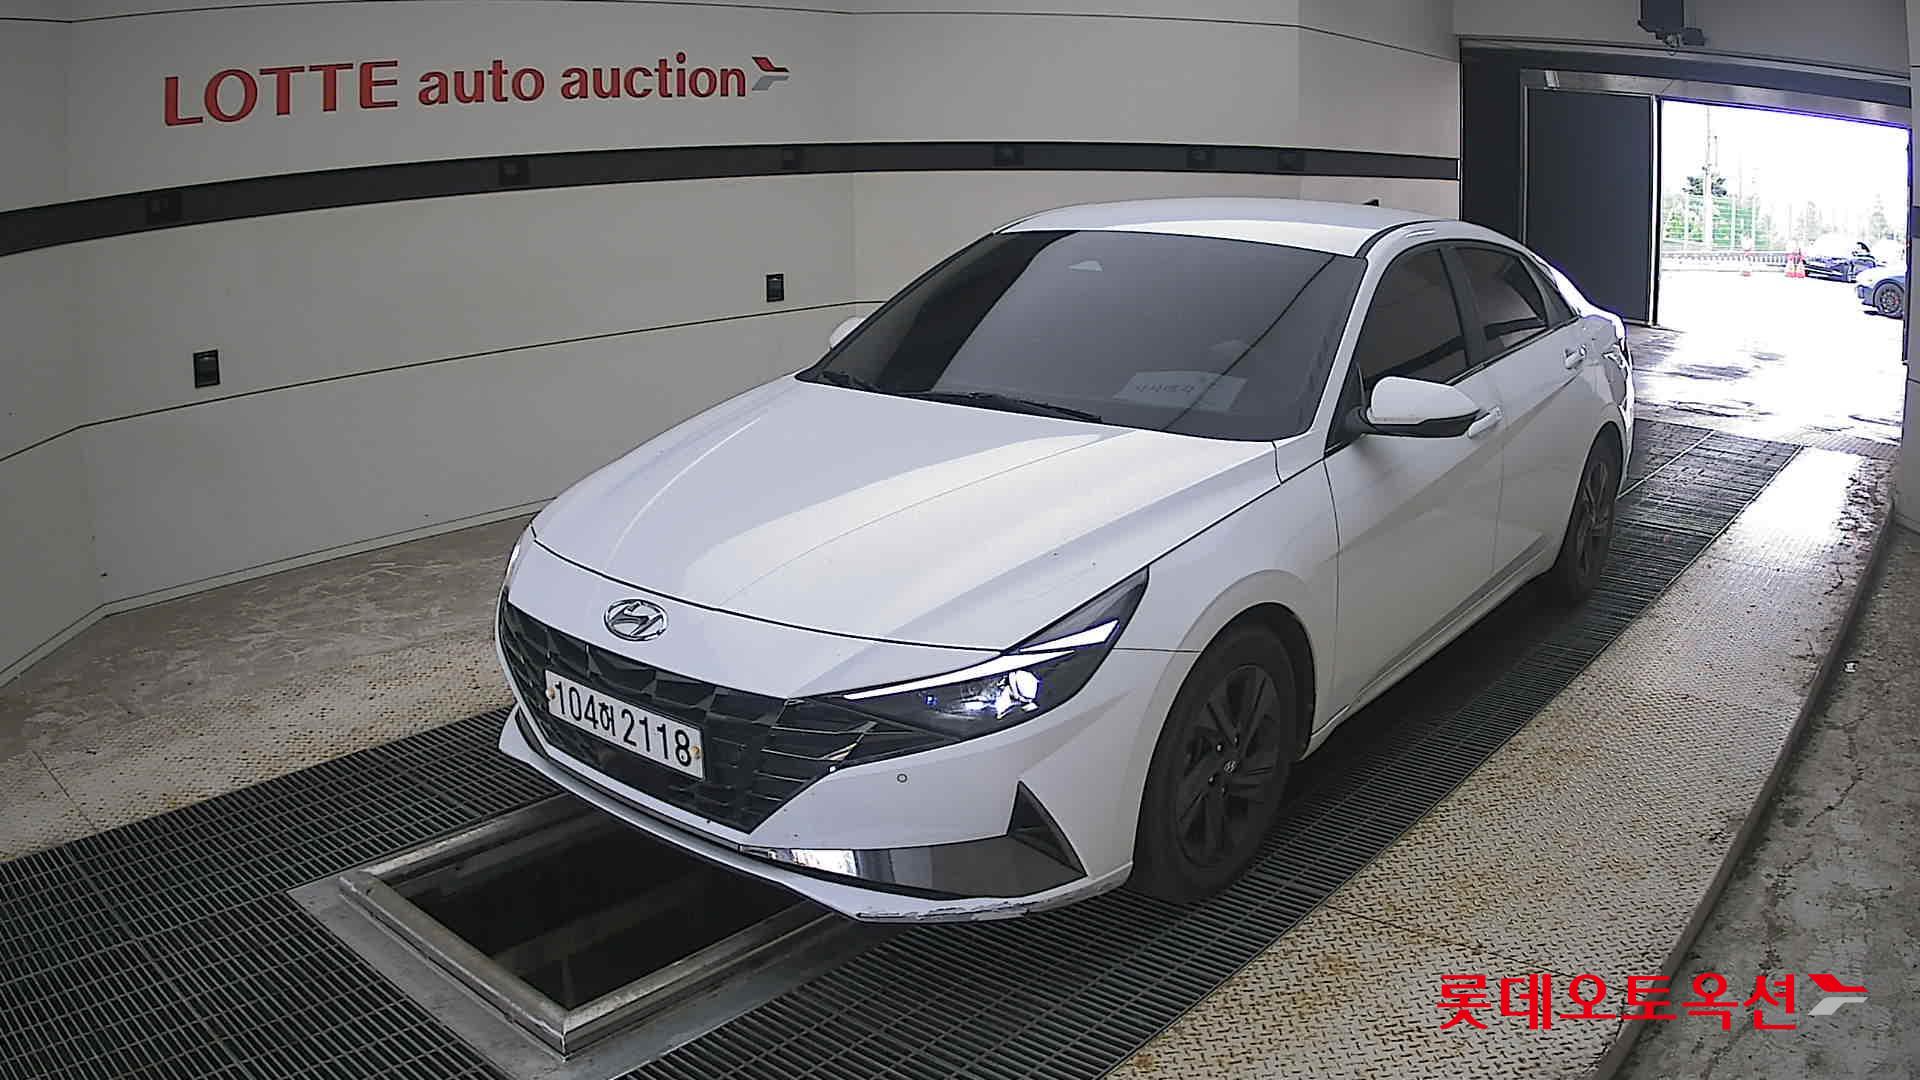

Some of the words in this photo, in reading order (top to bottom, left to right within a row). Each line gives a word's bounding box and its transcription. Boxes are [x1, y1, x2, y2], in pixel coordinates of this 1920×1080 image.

[163, 60, 399, 126] LOTTE
[417, 58, 546, 105] auto
[559, 51, 748, 99] auction
